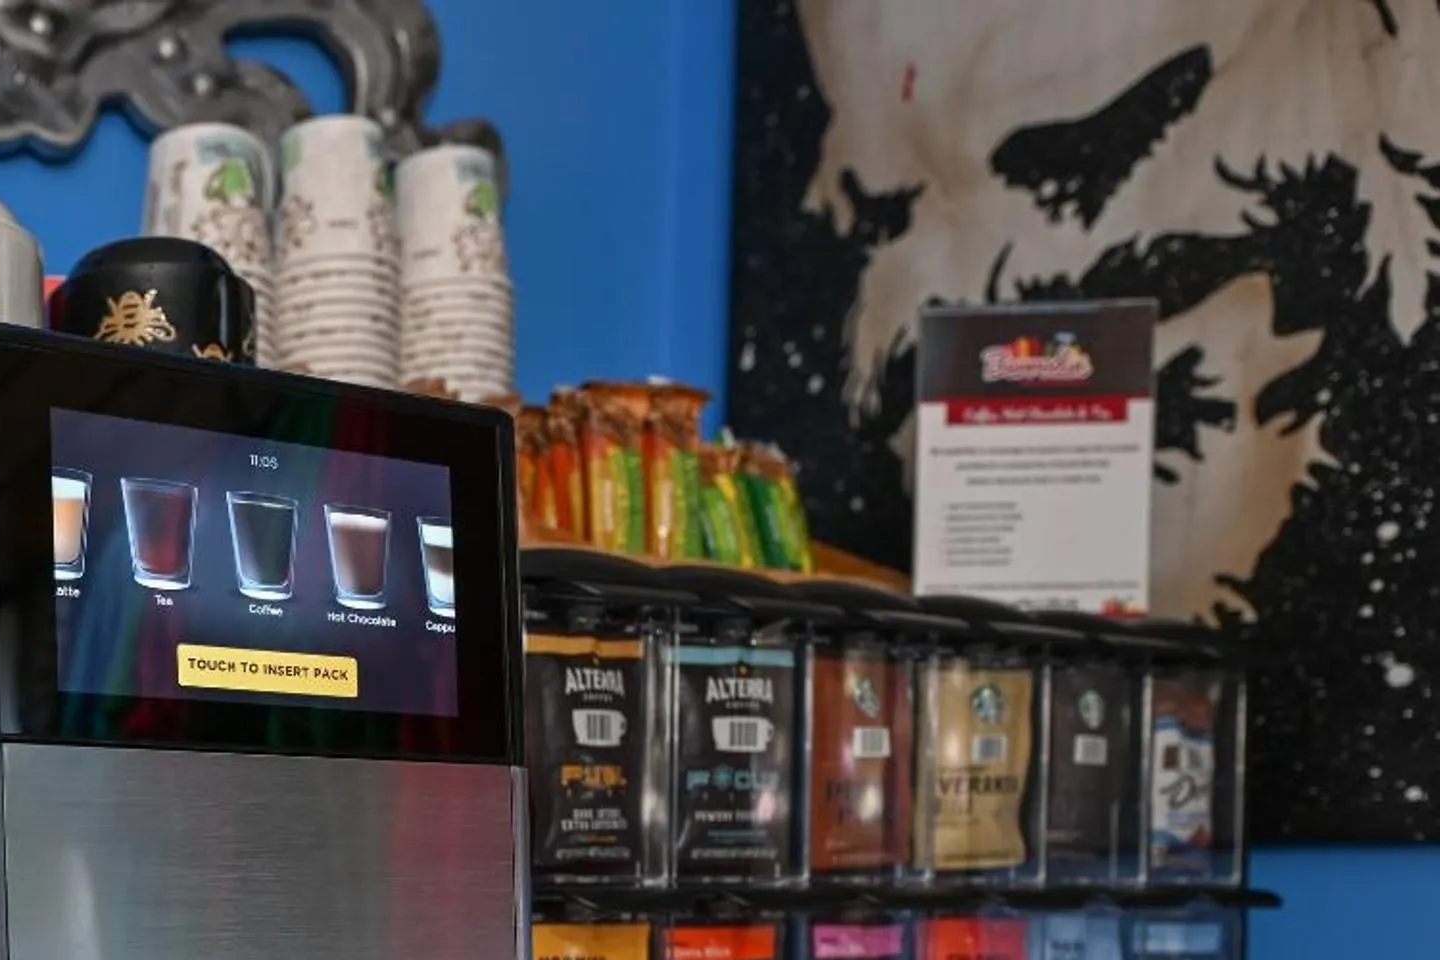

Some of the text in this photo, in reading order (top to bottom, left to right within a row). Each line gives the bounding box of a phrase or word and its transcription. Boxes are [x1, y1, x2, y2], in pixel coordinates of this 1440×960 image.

[153, 593, 174, 606] Tea
[248, 603, 284, 617] Coffee
[327, 611, 397, 628] Hot Chocolate
[188, 657, 349, 681] TOUCH TO INSERT PACK
